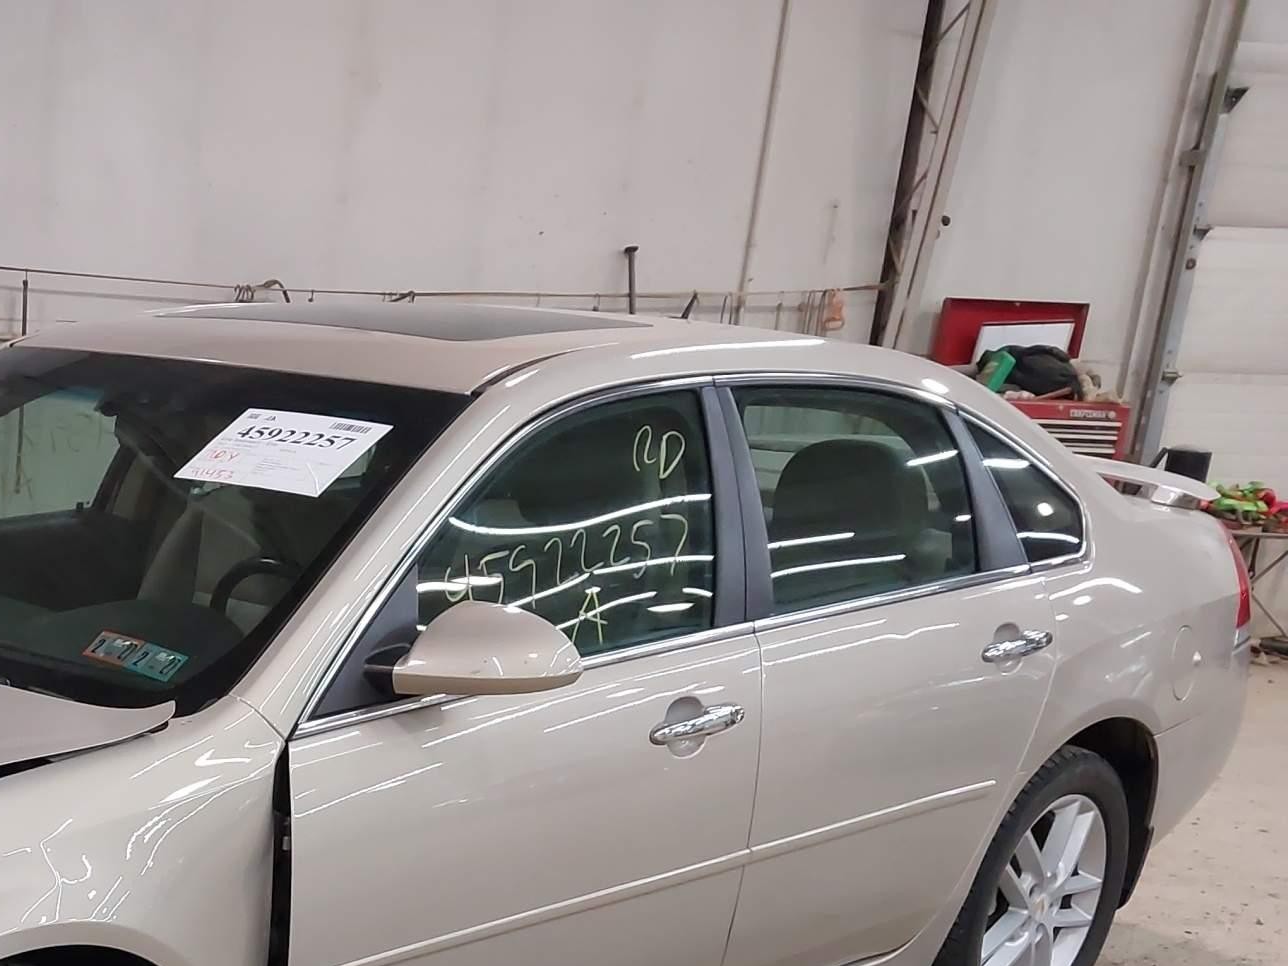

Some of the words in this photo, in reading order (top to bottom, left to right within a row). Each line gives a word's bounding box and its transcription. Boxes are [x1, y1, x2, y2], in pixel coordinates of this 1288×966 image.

[237, 425, 357, 450] 45922257
[444, 513, 689, 609] 45922257
[572, 587, 607, 645] A
